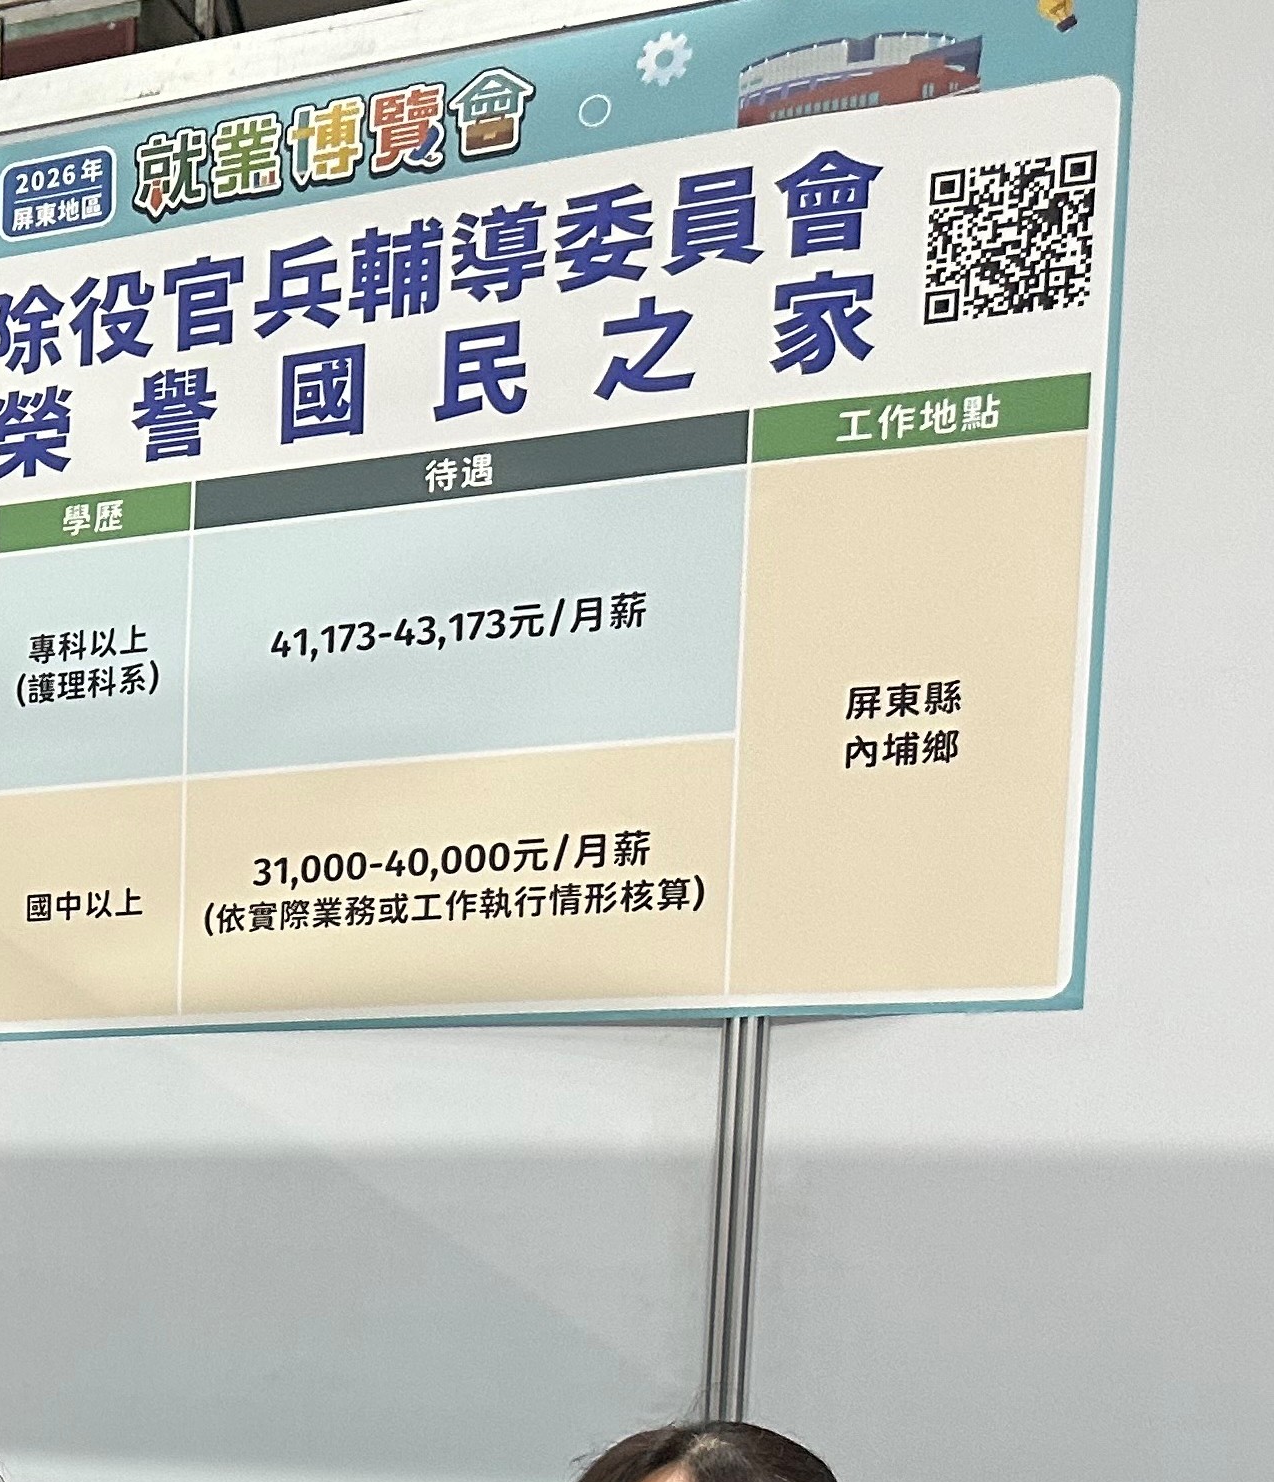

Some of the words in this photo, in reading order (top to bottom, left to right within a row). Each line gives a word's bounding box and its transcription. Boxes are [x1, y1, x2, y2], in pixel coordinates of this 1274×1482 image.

[134, 66, 535, 220] 就業博覽會
[12, 194, 102, 231] 屏東地區
[836, 394, 1001, 441] 工作地點
[424, 454, 494, 493] 待遇
[62, 500, 125, 534] 學歷
[28, 625, 148, 663] 專科以上
[269, 591, 648, 662] 41,173-43,173元/月薪
[16, 660, 160, 707] (護理科系)
[844, 679, 962, 722] 屏東縣
[844, 729, 960, 770] 內埔鄉
[252, 830, 652, 890] 31,000-40,000元/月薪
[26, 889, 143, 923] 國中以上
[203, 876, 705, 938] (依實際業務或工作執行情形核算)
